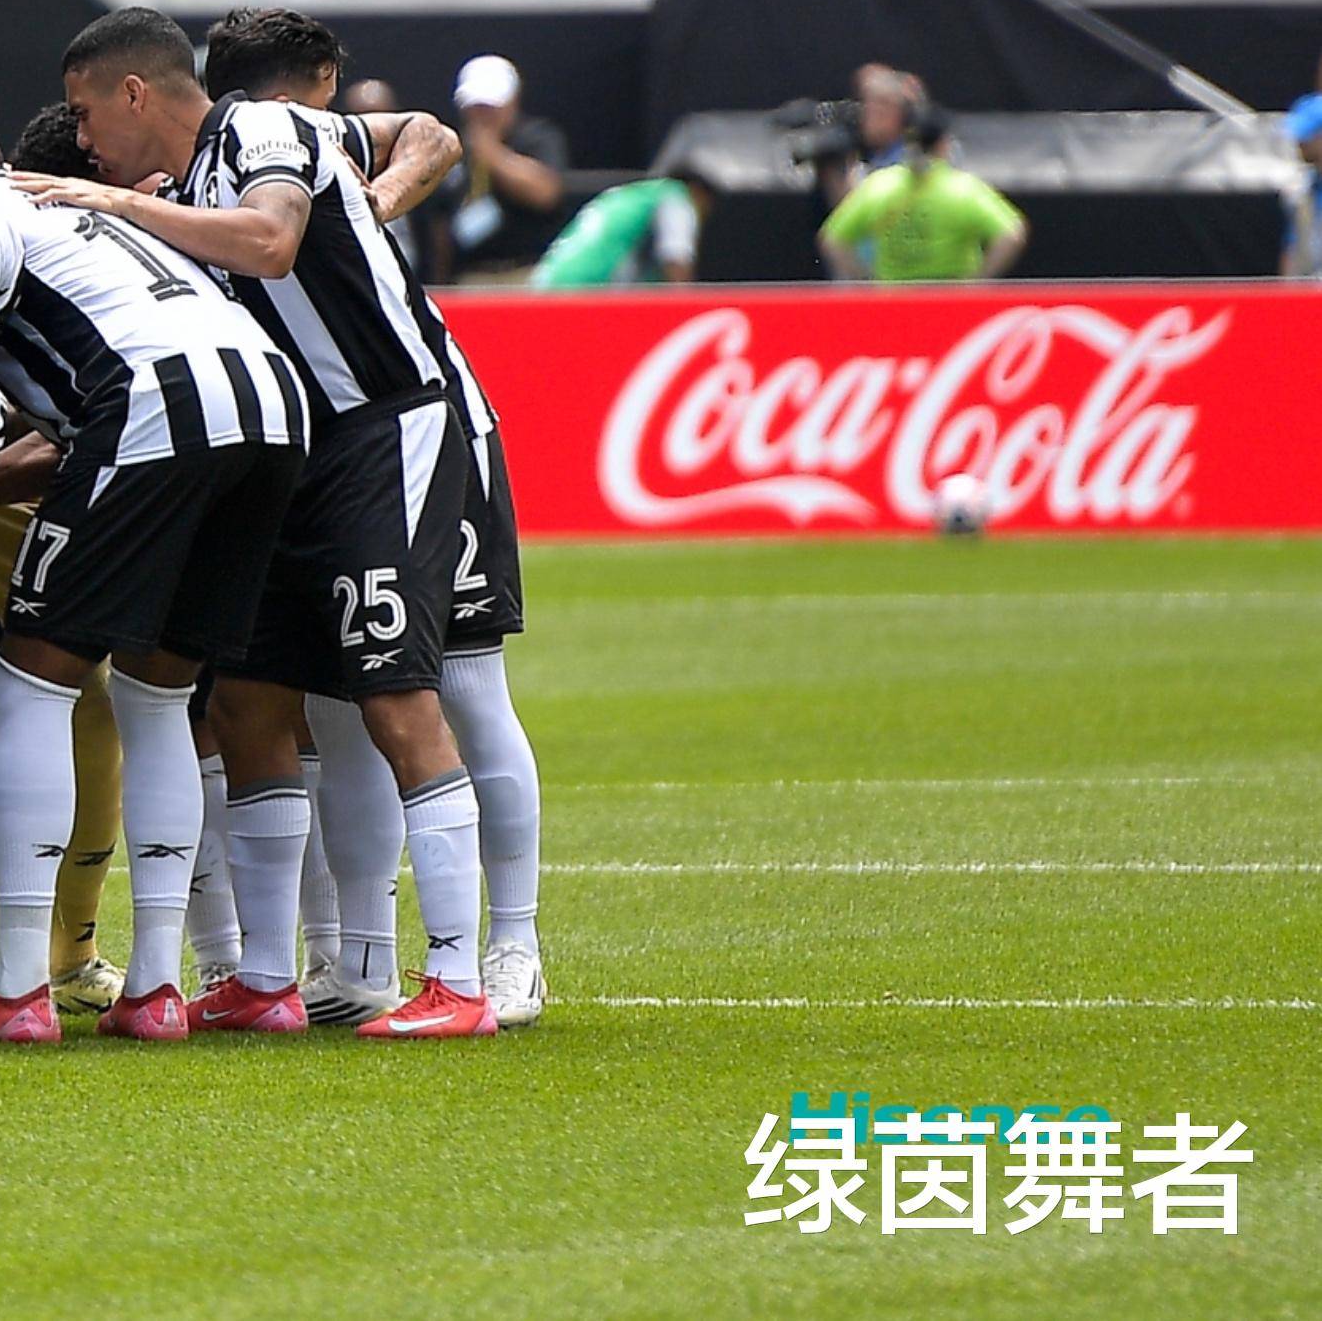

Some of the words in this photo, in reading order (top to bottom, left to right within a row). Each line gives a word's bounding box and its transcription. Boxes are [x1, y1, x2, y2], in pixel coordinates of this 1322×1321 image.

[597, 306, 1234, 527] Coca-Cola
[11, 517, 71, 594] 17
[332, 567, 408, 648] 25
